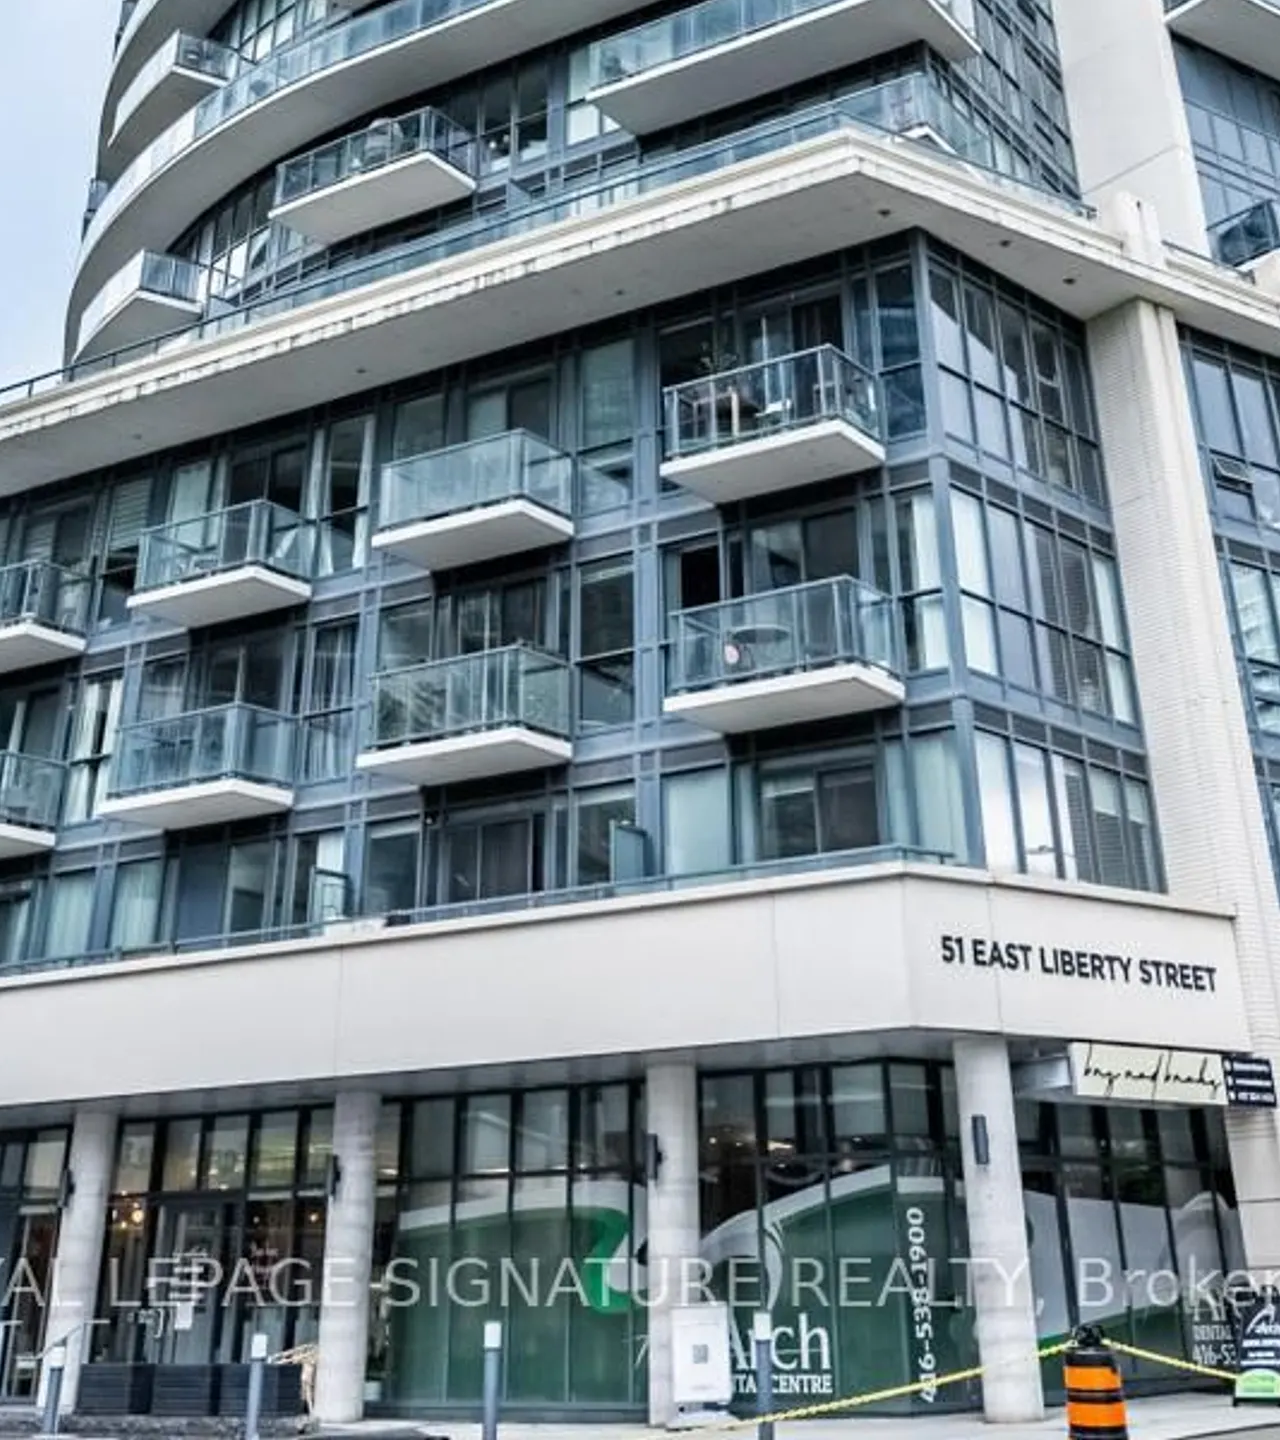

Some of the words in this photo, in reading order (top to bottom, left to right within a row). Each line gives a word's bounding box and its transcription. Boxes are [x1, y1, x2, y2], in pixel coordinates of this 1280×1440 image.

[941, 935, 964, 964] 51
[971, 938, 1032, 971] EAST
[1039, 946, 1131, 984] LIBERTY
[1139, 959, 1217, 992] STREET
